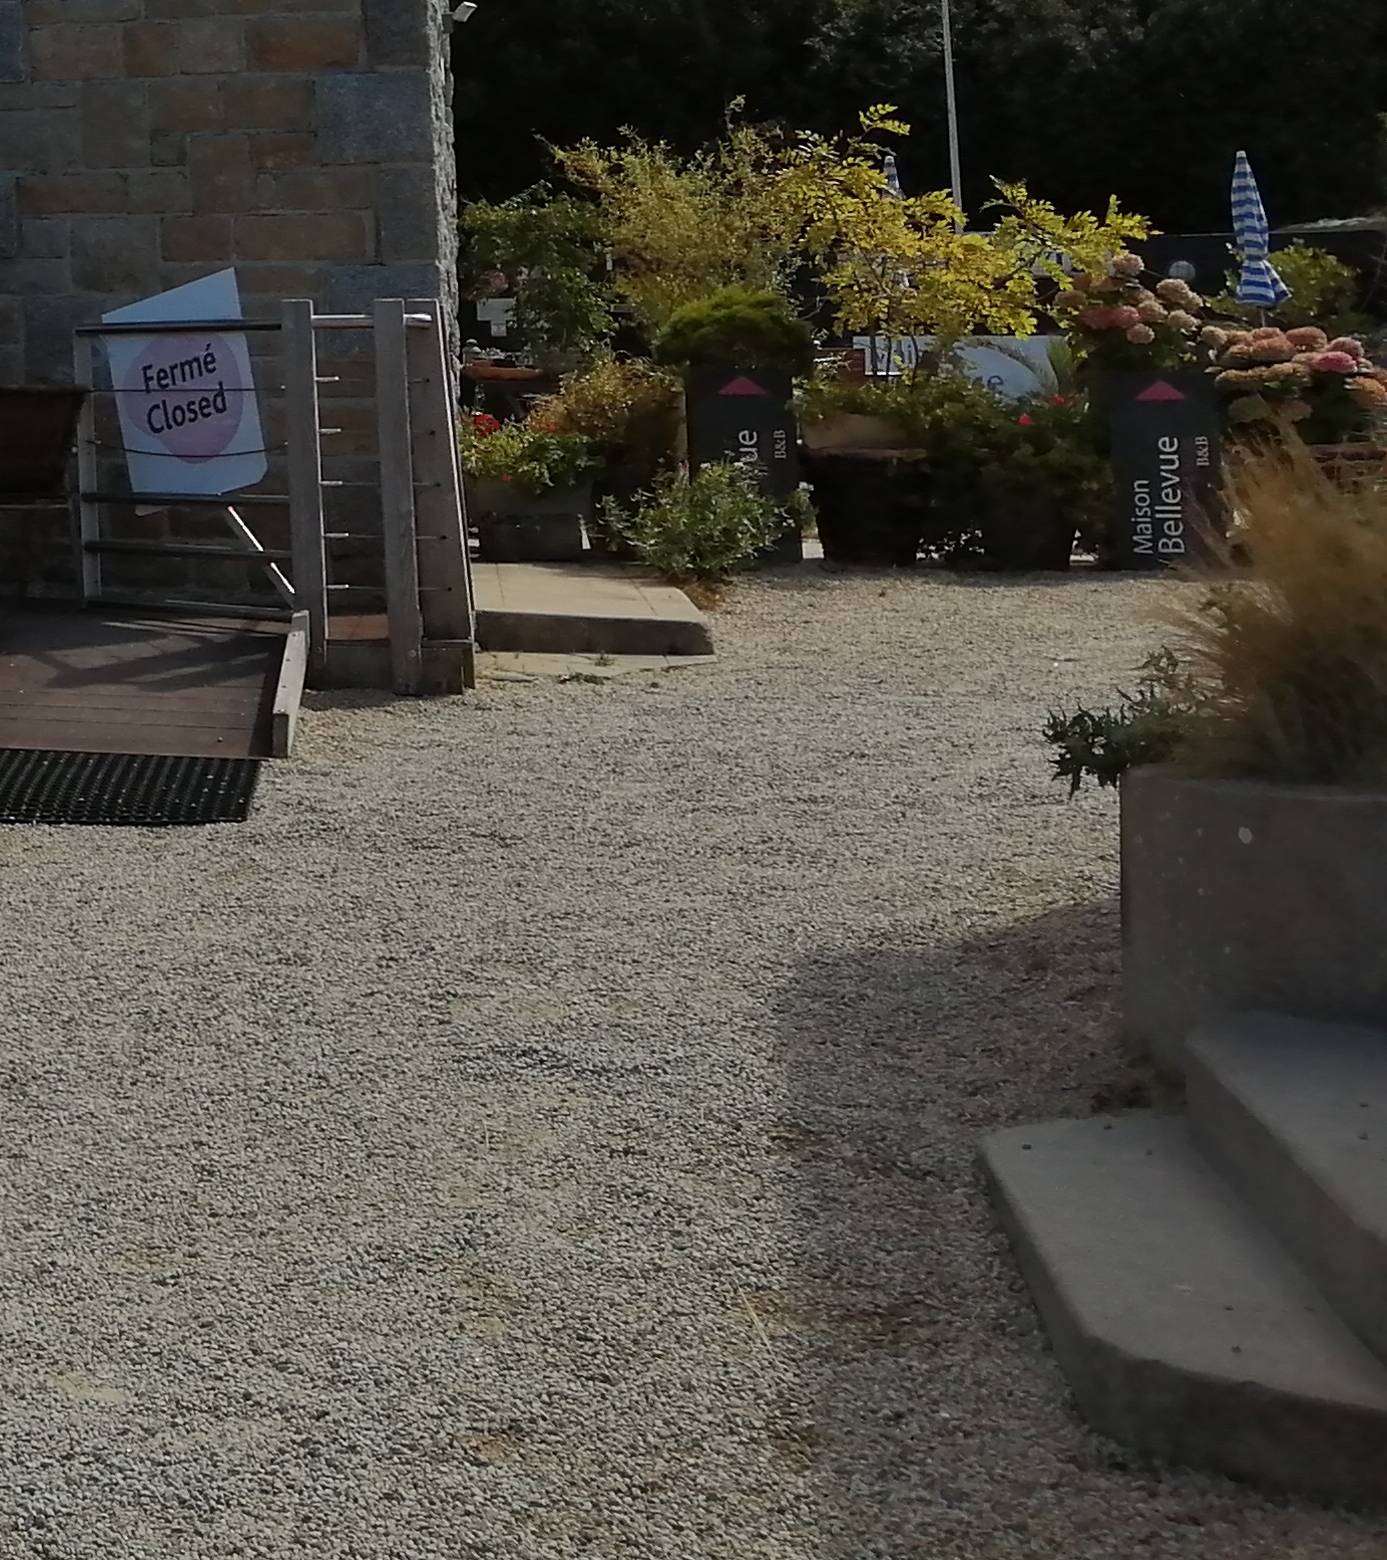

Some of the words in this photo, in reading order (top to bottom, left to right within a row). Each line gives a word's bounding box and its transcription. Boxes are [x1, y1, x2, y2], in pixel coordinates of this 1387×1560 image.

[141, 343, 217, 394] Fermé
[146, 381, 228, 434] Closed
[773, 429, 787, 459] B&B
[1195, 436, 1210, 466] B&B
[1131, 480, 1154, 554] Maison
[1155, 436, 1185, 553] Bellevue
